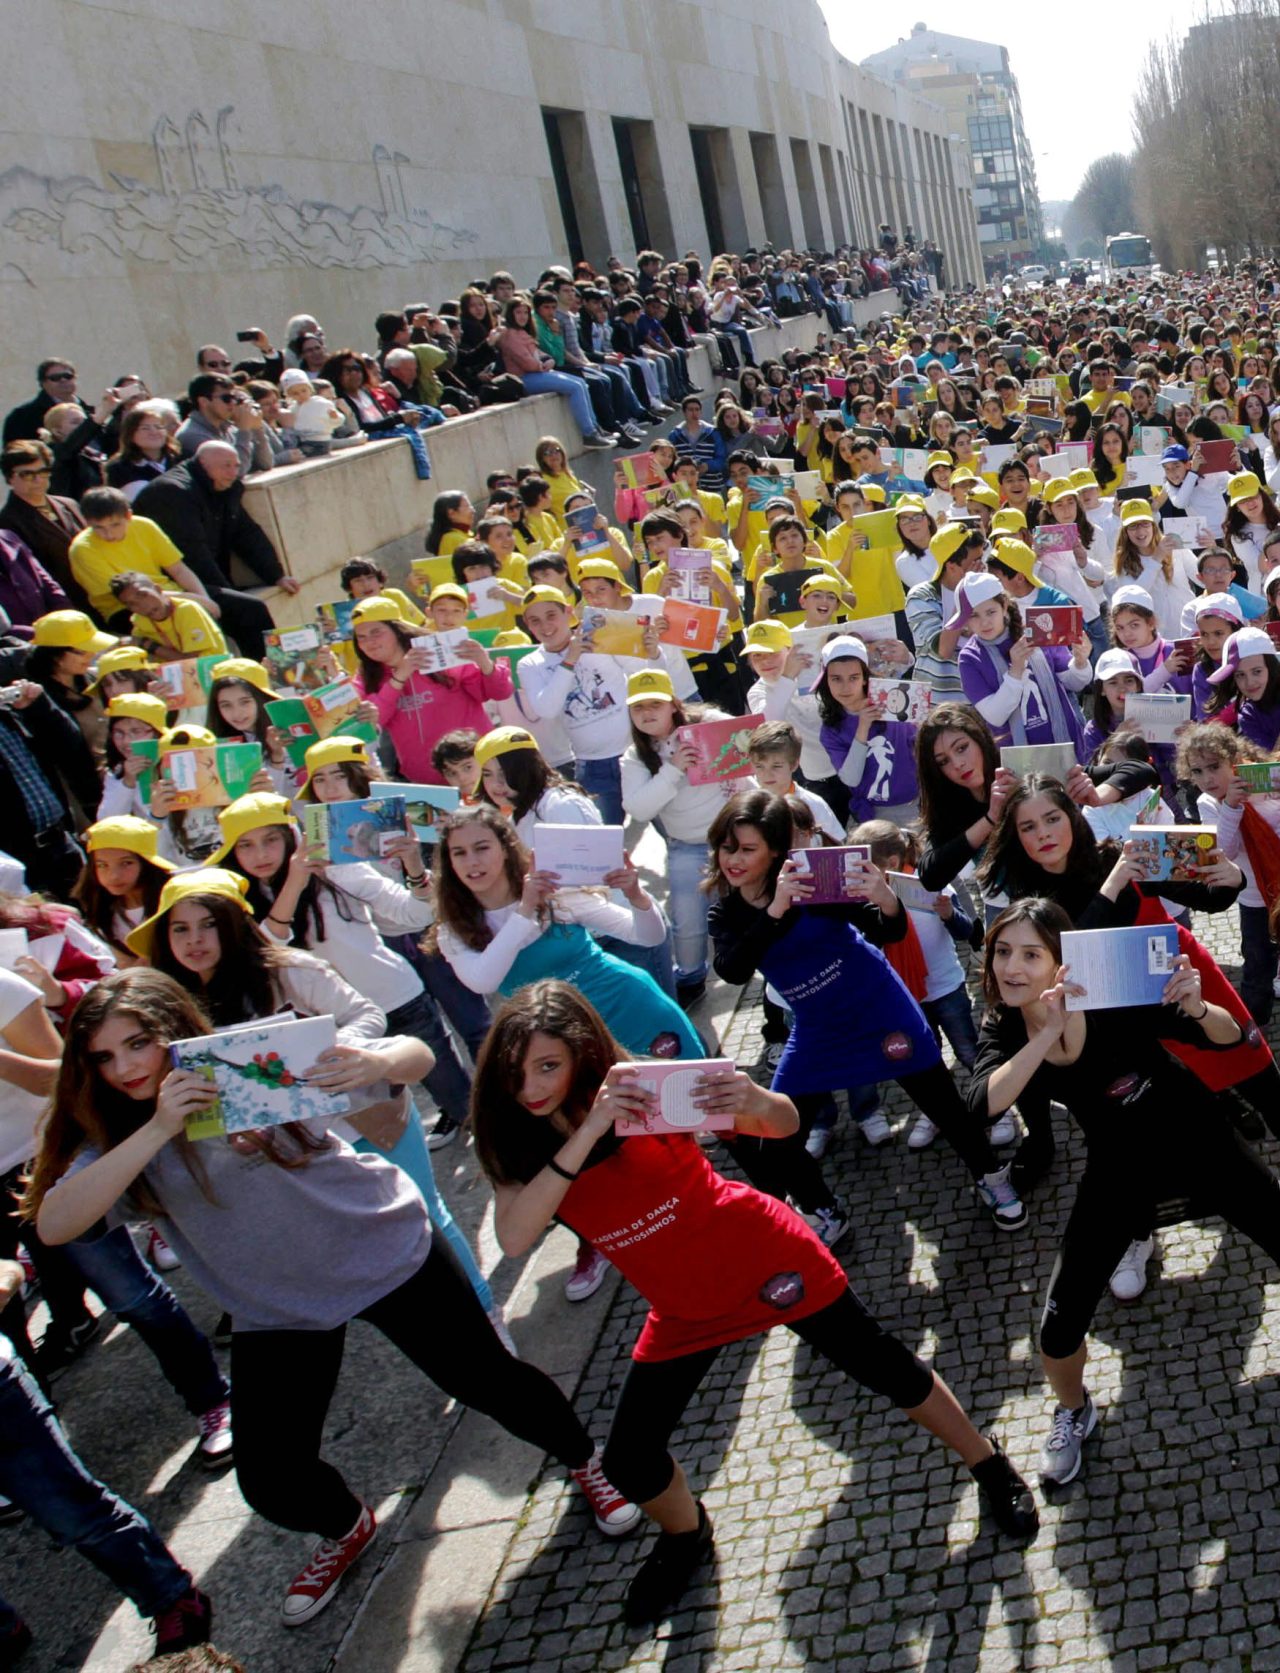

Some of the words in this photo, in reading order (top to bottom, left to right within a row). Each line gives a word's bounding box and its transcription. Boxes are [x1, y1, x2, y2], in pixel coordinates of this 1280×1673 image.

[808, 976, 819, 985] DE
[616, 1213, 677, 1249] MATOSINHOS
[631, 1217, 646, 1231] DE
[646, 1196, 680, 1221] DANÇA
